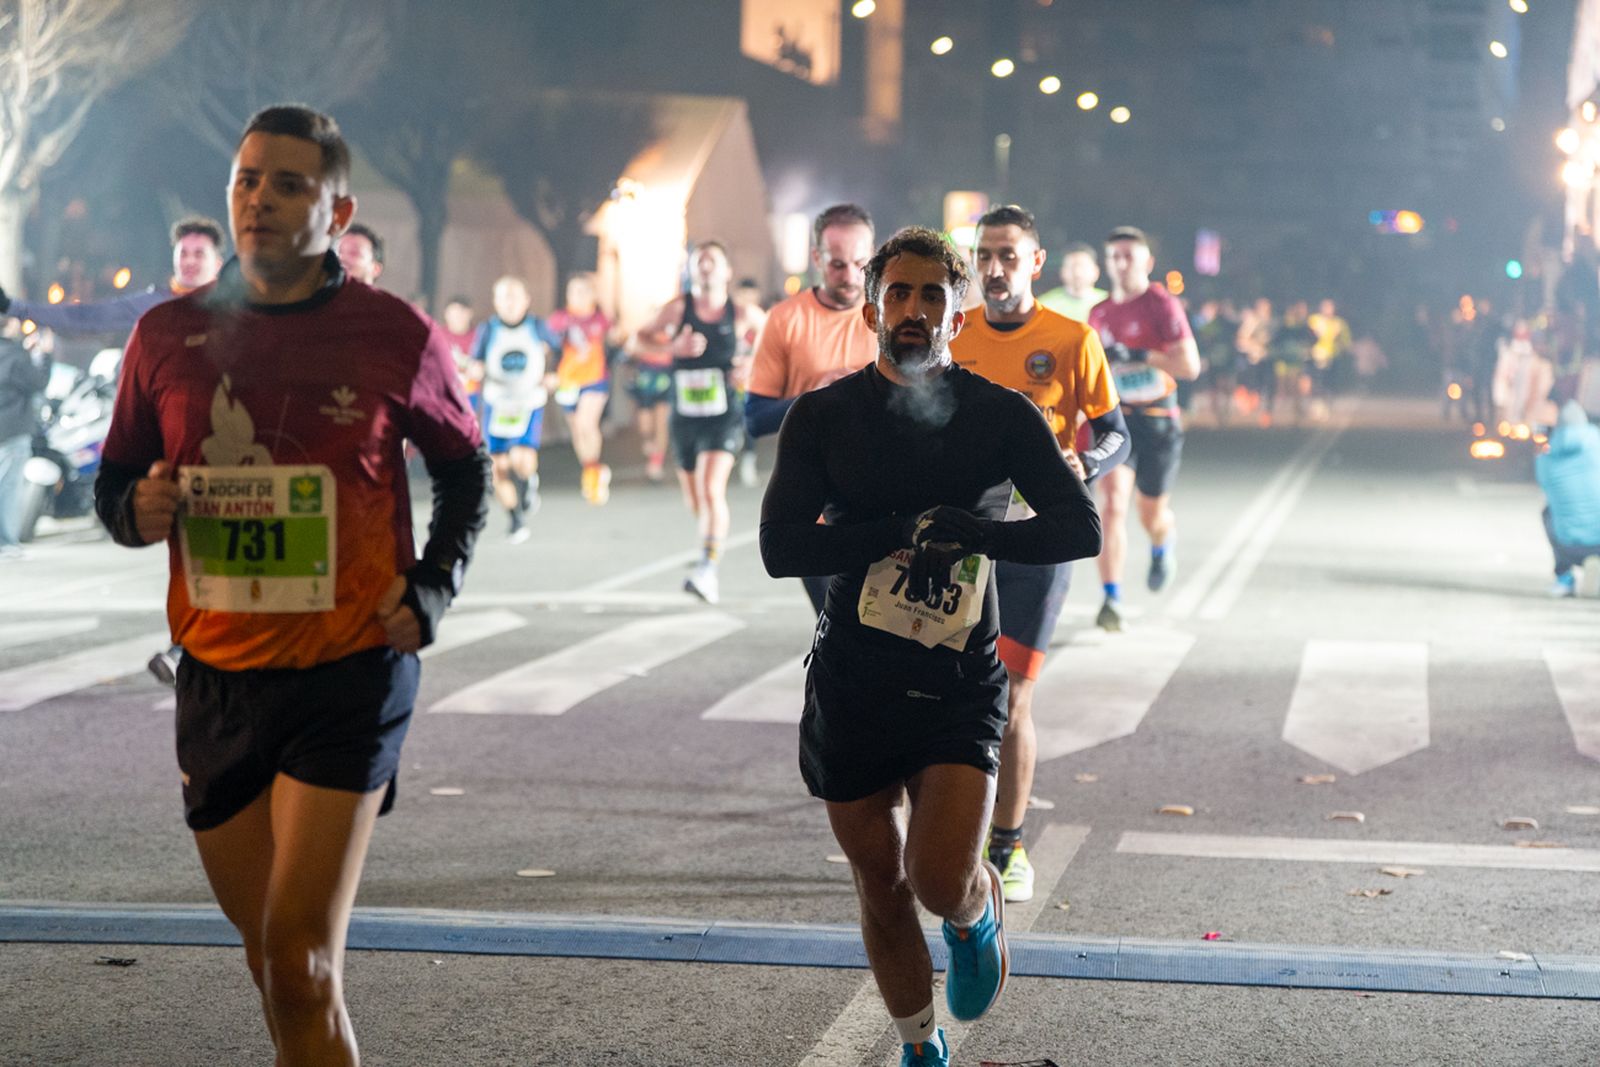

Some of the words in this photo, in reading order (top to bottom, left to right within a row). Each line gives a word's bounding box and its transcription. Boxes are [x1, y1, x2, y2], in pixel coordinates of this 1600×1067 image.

[207, 484, 253, 498] NOCHE
[257, 483, 274, 497] DE
[193, 500, 220, 515] SAN
[222, 518, 285, 562] 731
[894, 600, 912, 612] Juan
